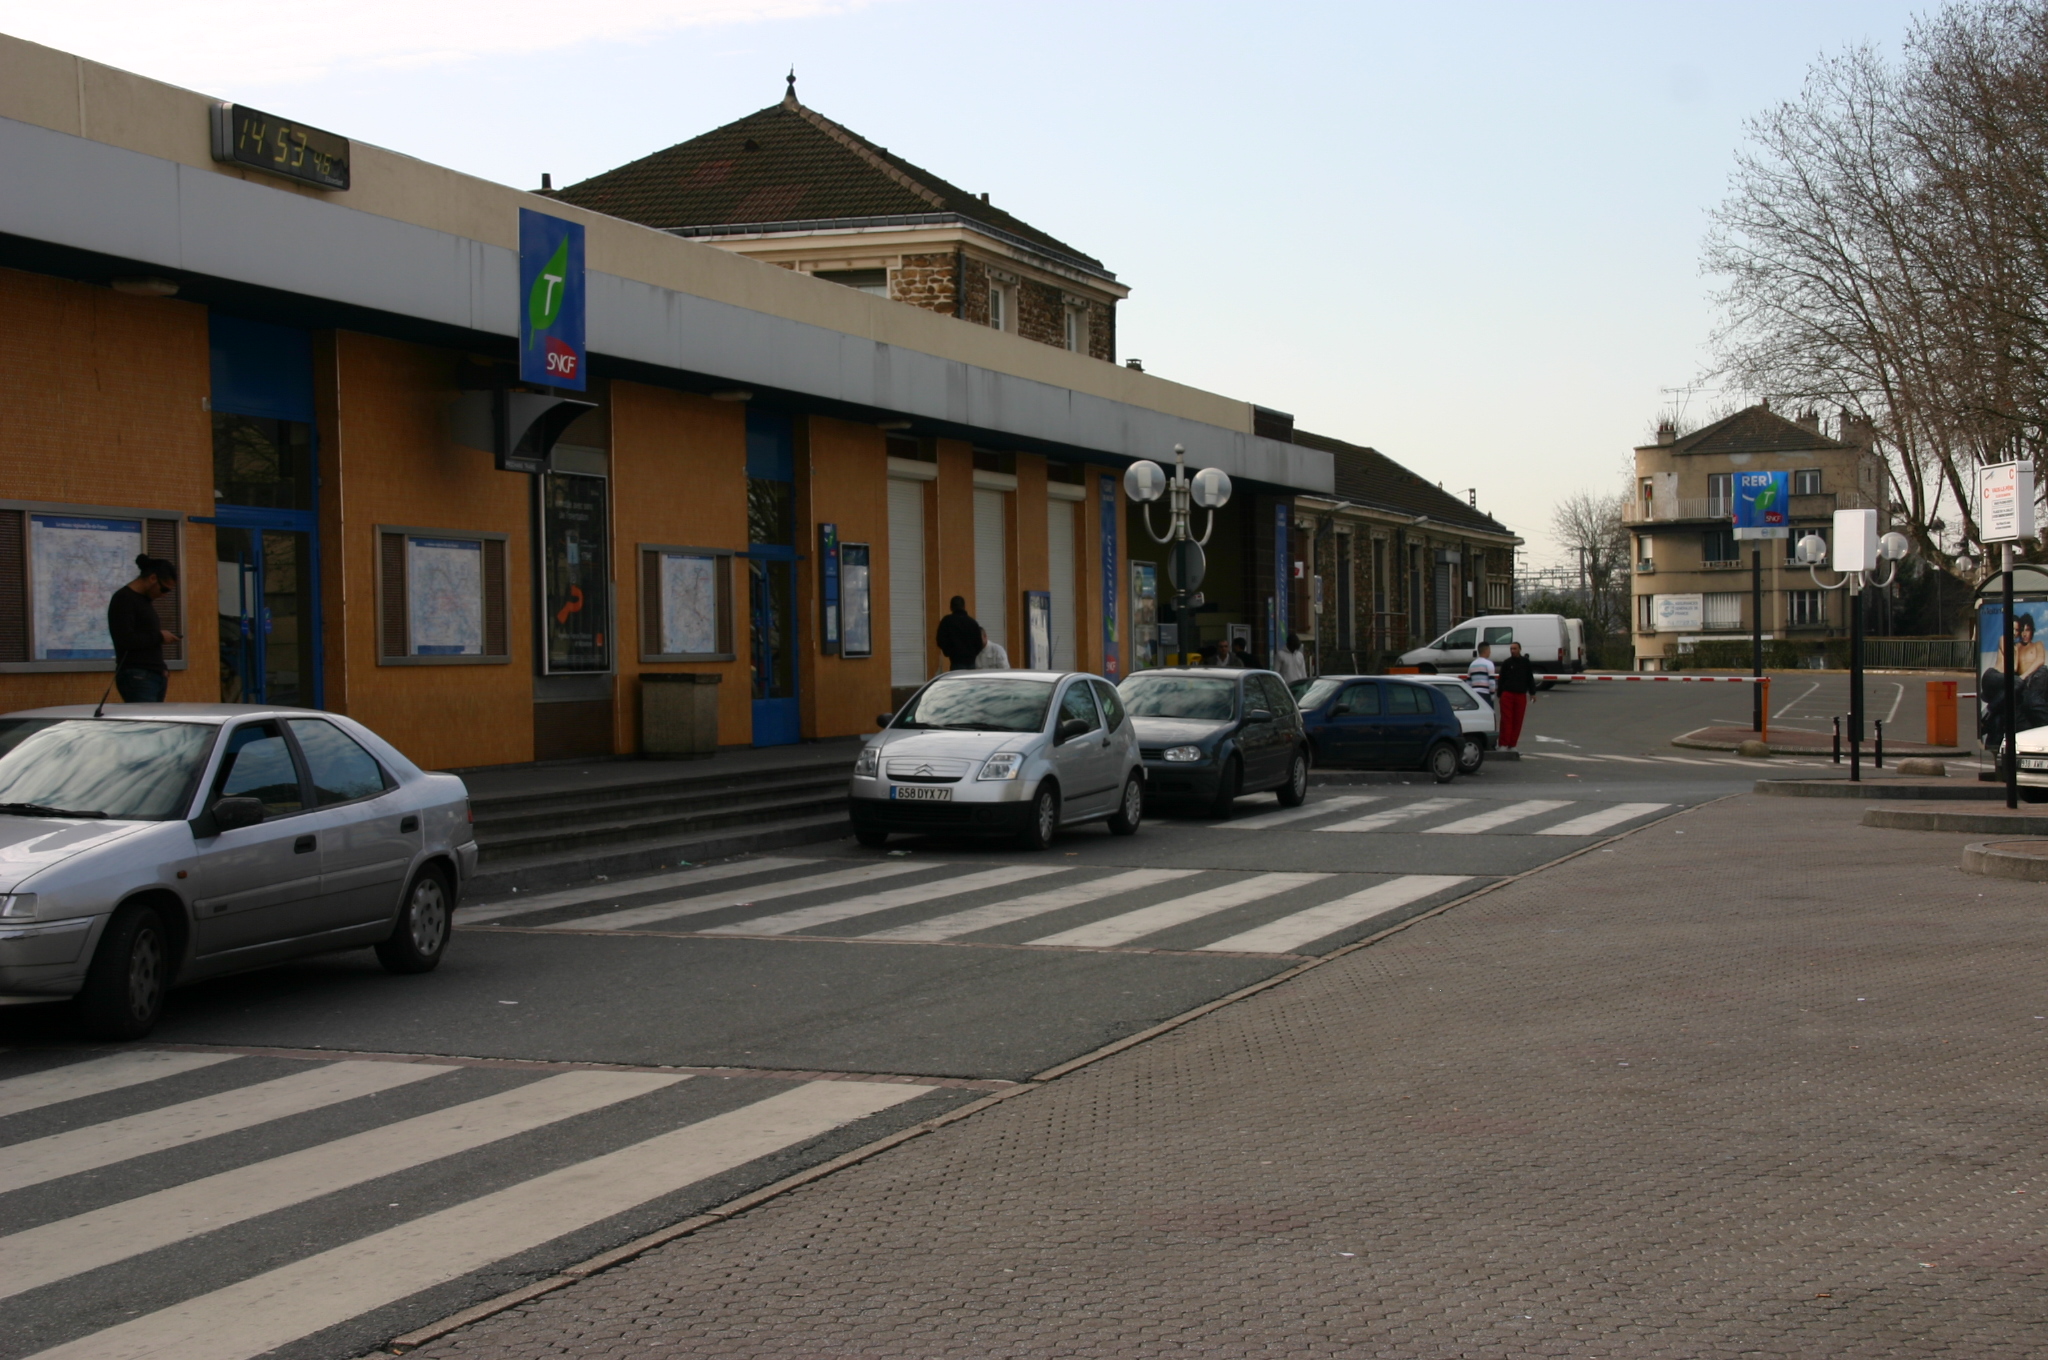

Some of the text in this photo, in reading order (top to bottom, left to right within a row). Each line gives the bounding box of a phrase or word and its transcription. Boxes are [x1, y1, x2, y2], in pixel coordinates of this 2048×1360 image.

[240, 118, 267, 155] 14
[274, 127, 308, 168] 53
[543, 273, 562, 316] T
[547, 352, 576, 373] SNCF
[1741, 475, 1767, 487] RER
[1764, 491, 1775, 505] T
[898, 788, 950, 800] 658 DYX 77
